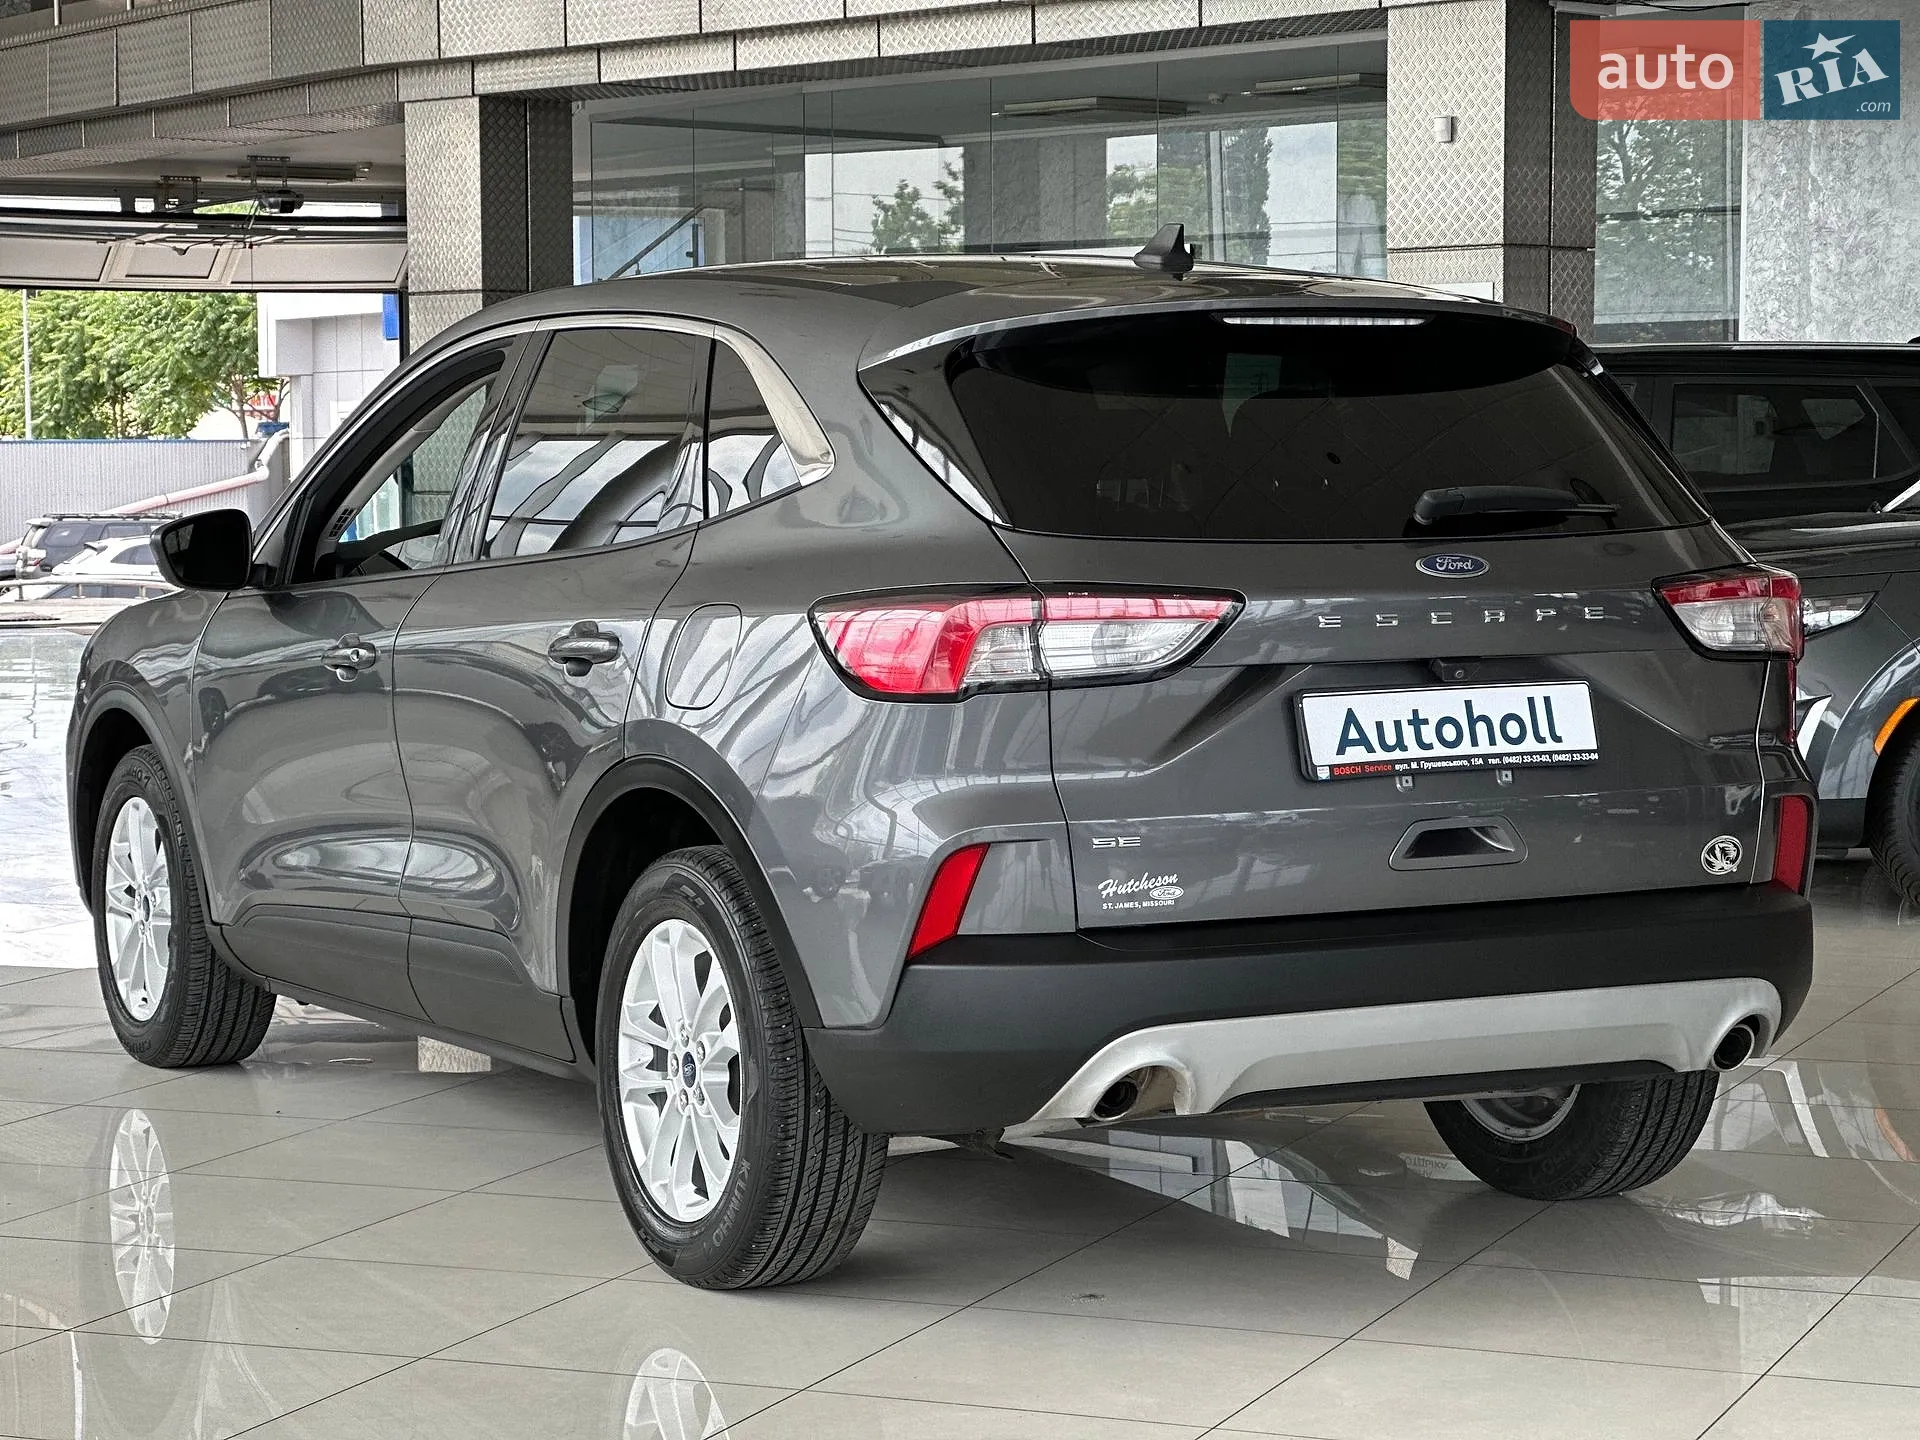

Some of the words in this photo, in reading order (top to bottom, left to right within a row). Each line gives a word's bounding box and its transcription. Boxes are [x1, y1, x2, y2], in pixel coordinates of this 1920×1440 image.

[1435, 556, 1474, 571] Ford
[1318, 606, 1605, 628] ESCAPE
[1336, 696, 1562, 756] Autoholl
[1333, 766, 1361, 775] BOSCH
[1365, 763, 1392, 773] Service
[1092, 836, 1141, 849] SE
[1097, 872, 1179, 899] Hutcheson
[1102, 902, 1114, 910] ST.
[1115, 900, 1141, 909] JAMES,
[1142, 899, 1175, 908] MISSOURI
